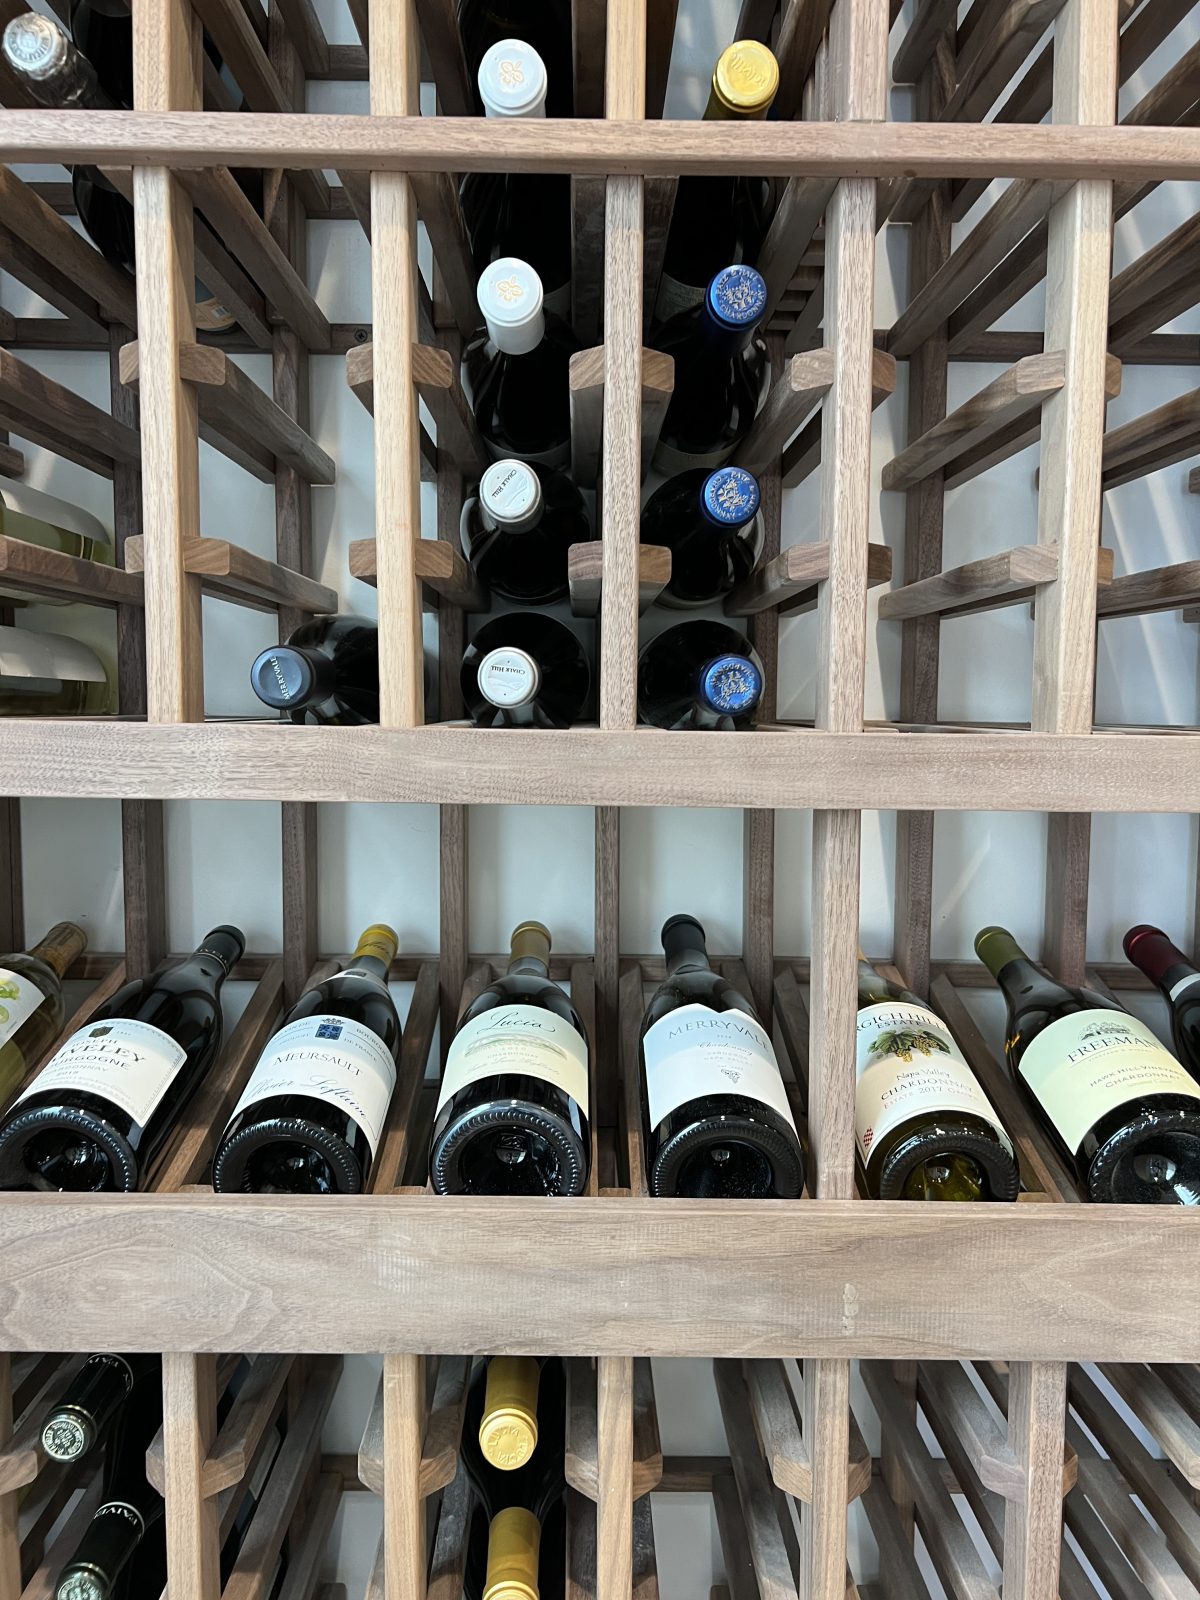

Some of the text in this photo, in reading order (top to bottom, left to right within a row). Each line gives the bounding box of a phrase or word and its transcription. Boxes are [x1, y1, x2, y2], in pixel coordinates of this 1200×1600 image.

[720, 289, 765, 320] CHARDONNAY
[491, 469, 518, 498] CHALK HILL
[269, 655, 291, 700] MERRYVALE
[490, 664, 526, 676] CHALK HILL
[476, 1011, 556, 1035] Lucia
[273, 1051, 362, 1077] MEURSAULT
[880, 1078, 973, 1101] CHARDONNAY
[896, 1074, 921, 1082] Napa
[1105, 1072, 1182, 1088] CHARDONNAY
